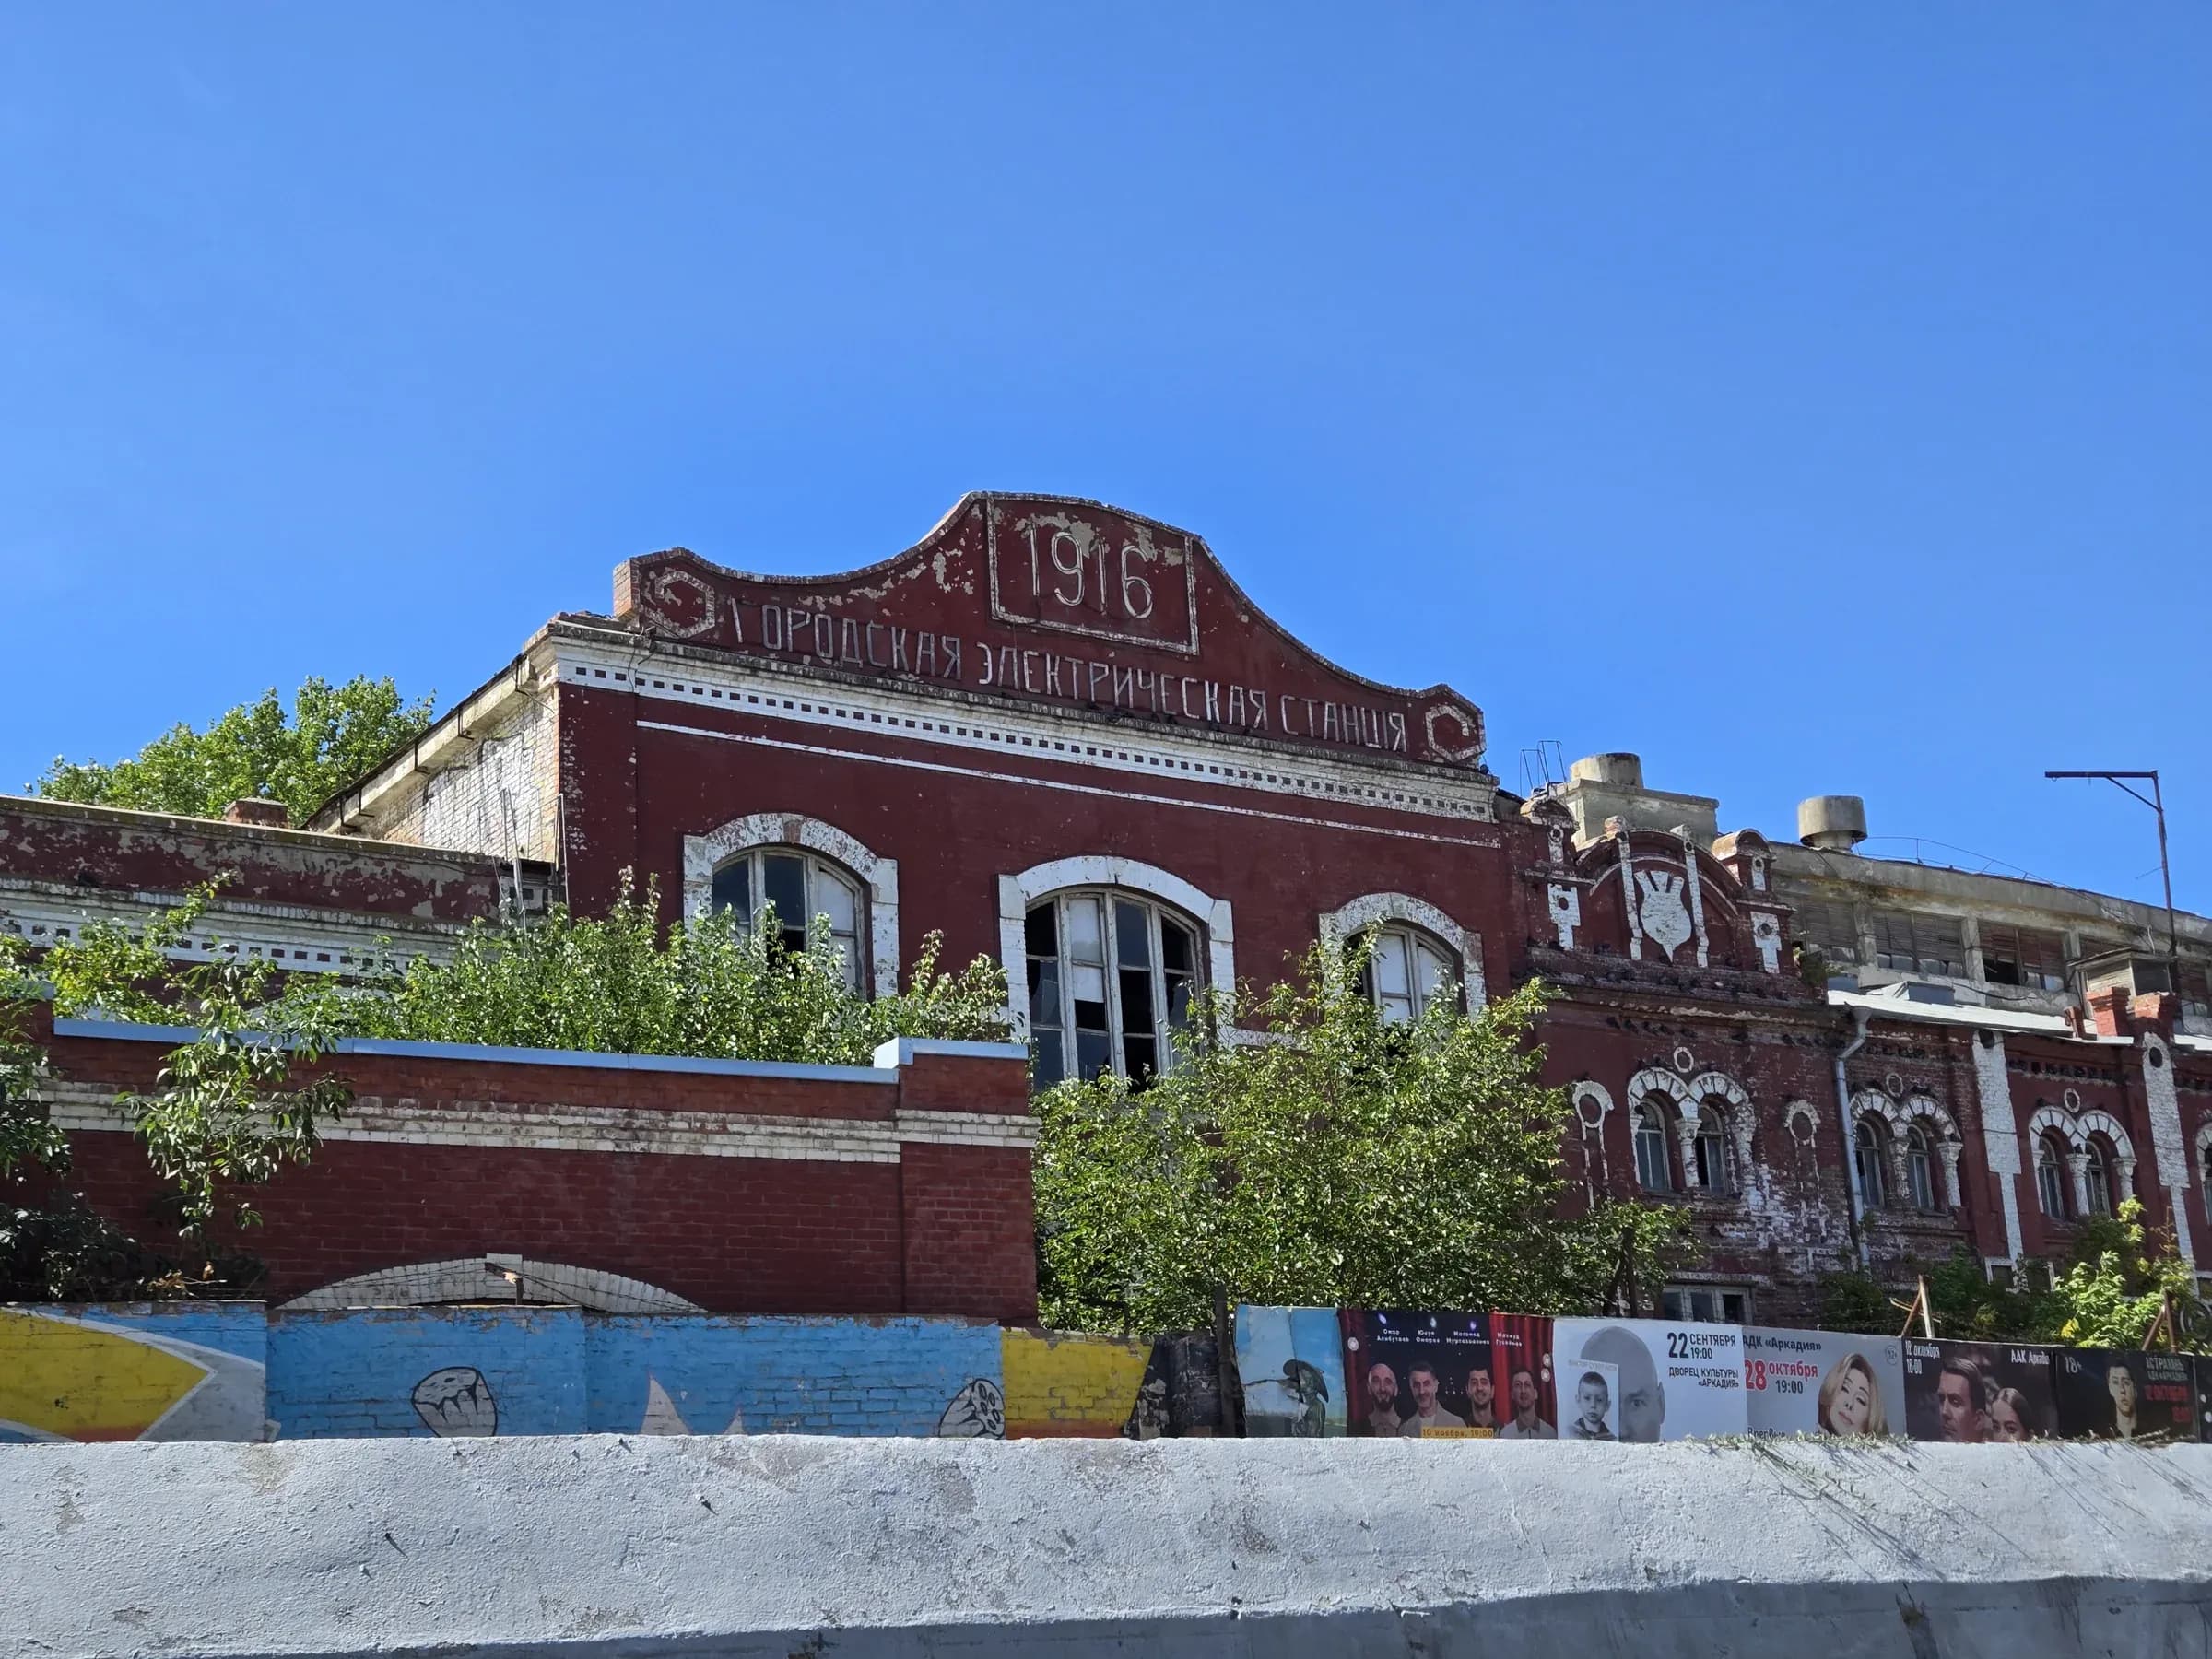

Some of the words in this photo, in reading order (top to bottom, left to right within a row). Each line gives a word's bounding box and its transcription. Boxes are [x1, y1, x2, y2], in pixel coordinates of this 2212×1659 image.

[1022, 522, 1152, 618] 1916
[977, 642, 1268, 730] ЭЛЕКТРИЧЕСКАЯ
[1667, 1333, 1688, 1358] 22
[1690, 1334, 1735, 1347] СЕНТЯБРЯ
[1743, 1335, 1762, 1349] АДК
[1765, 1337, 1821, 1353] «Аркадия»
[1690, 1347, 1712, 1359] 19:00
[1669, 1367, 1700, 1378] ДВОРЕЦ
[1700, 1368, 1739, 1379] КУЛЬТУРЫ
[2065, 1357, 2082, 1373] 18+
[1745, 1359, 1767, 1390] 28
[1769, 1361, 1818, 1382] октября
[1699, 1379, 1739, 1389] «АРКАДИЯ»
[1775, 1379, 1803, 1394] 19:00
